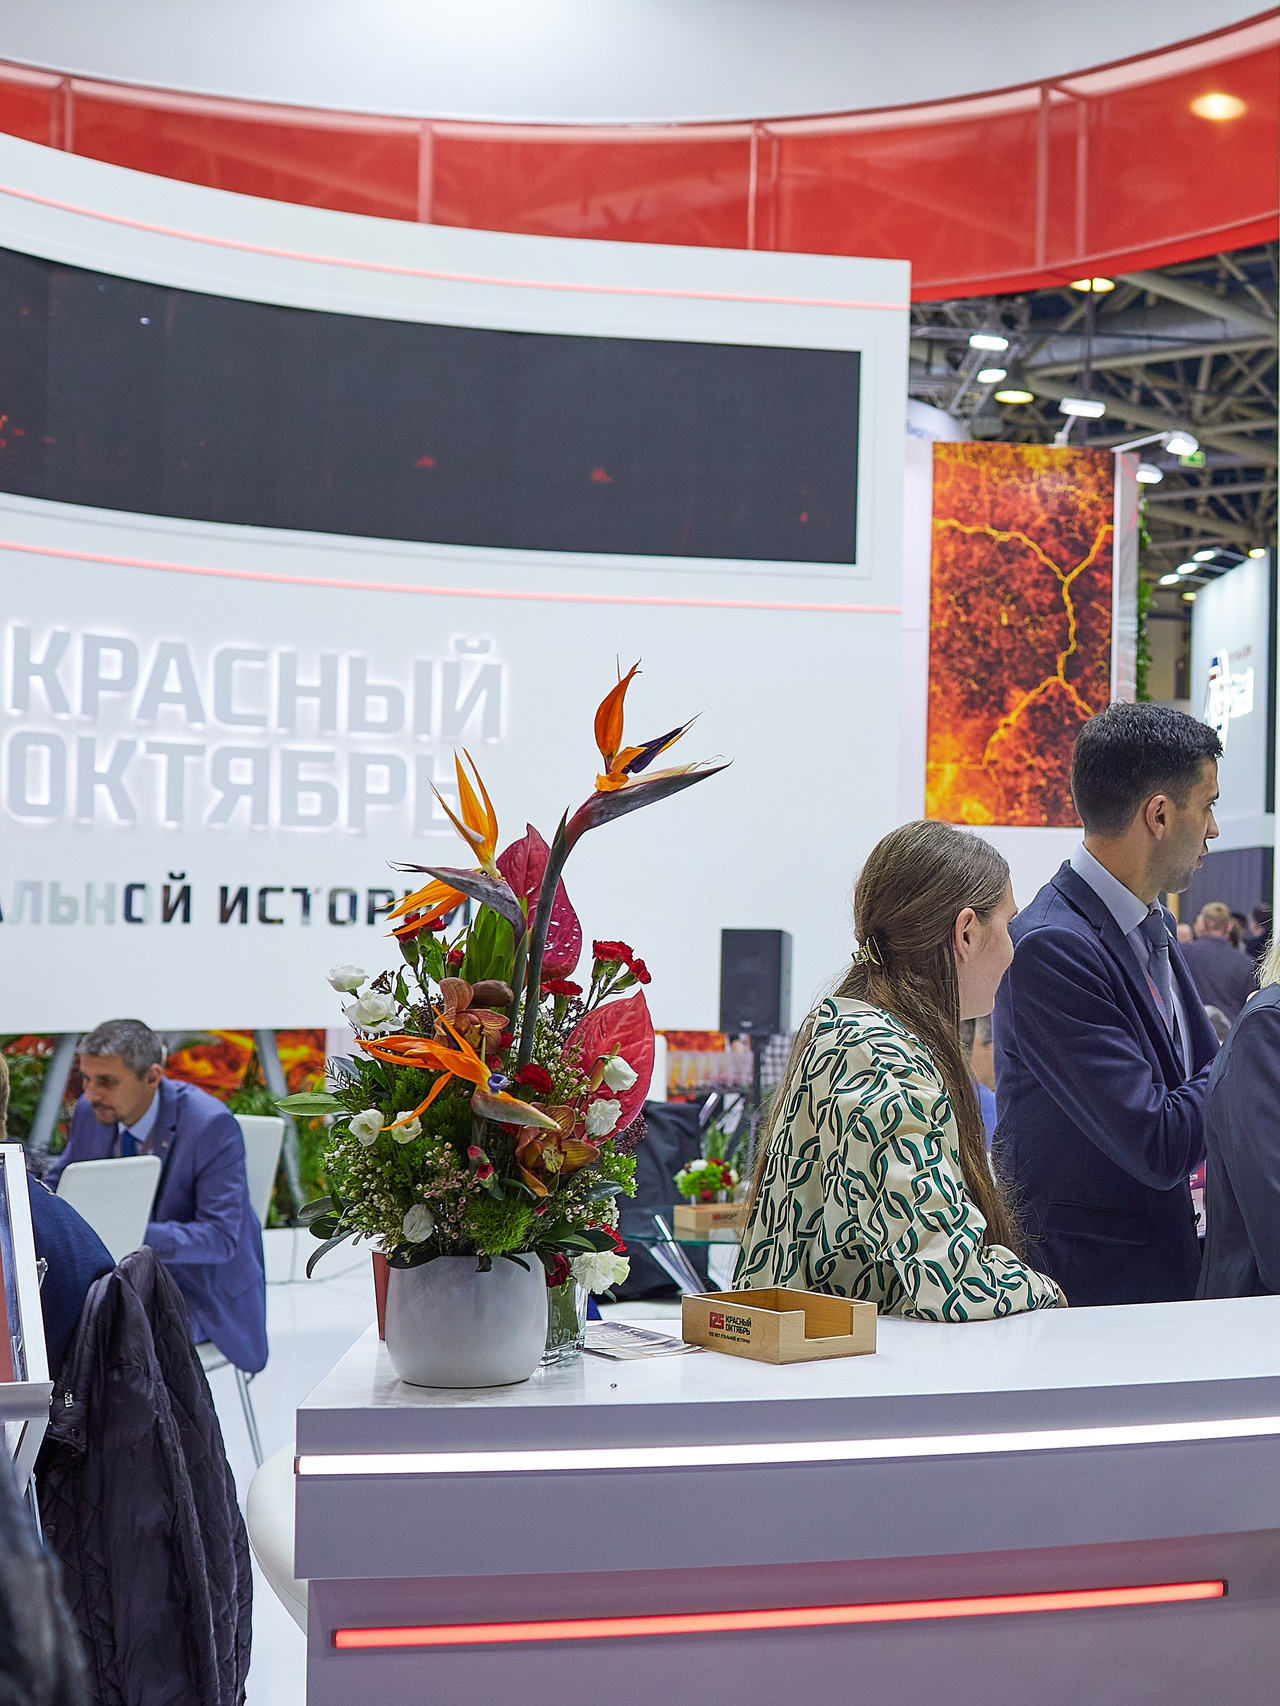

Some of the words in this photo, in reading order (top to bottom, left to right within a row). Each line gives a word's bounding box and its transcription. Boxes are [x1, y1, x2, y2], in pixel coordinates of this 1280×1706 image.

[11, 625, 502, 742] КРАСНЫЙ
[8, 731, 464, 835] ОКТЯБРЬ
[0, 872, 191, 925] ЛЬНОЙ
